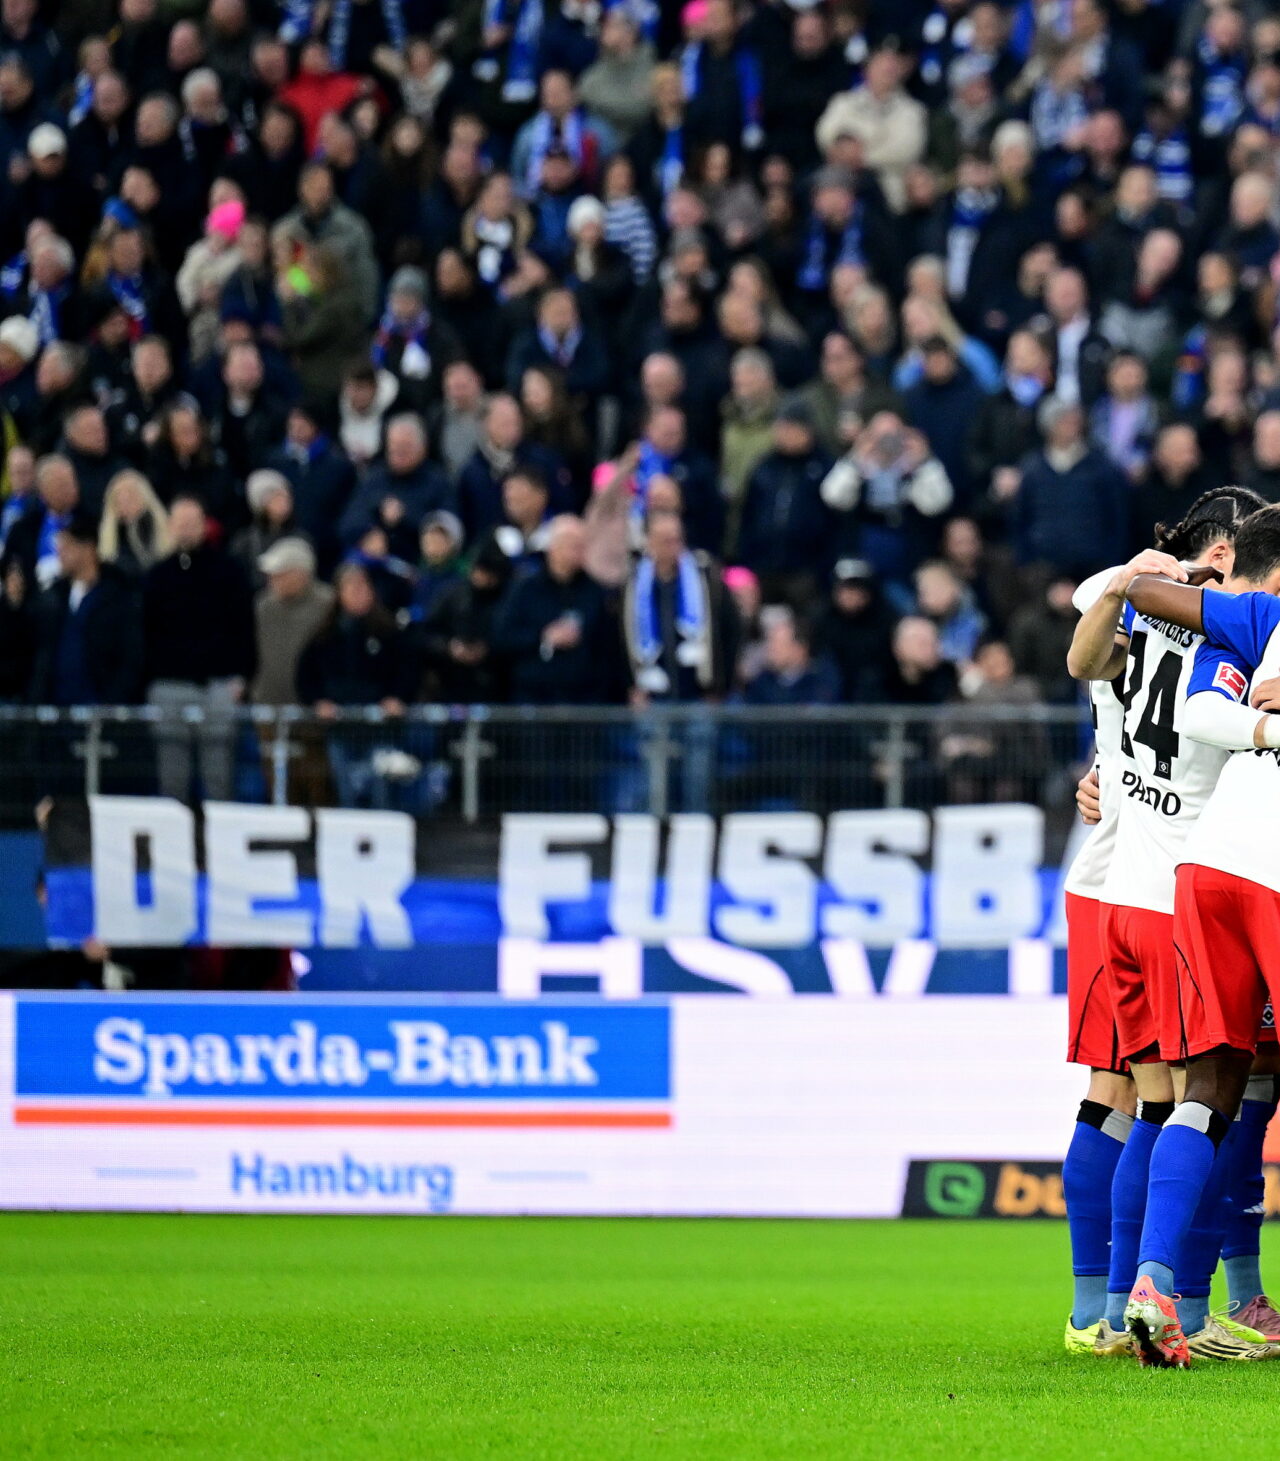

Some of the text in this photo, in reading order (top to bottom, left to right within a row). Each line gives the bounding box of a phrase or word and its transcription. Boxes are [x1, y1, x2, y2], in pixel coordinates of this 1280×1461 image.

[89, 796, 1068, 949] DER FUSSB
[94, 1016, 599, 1097] Sparda-Bank
[230, 1152, 456, 1212] Hamburg
